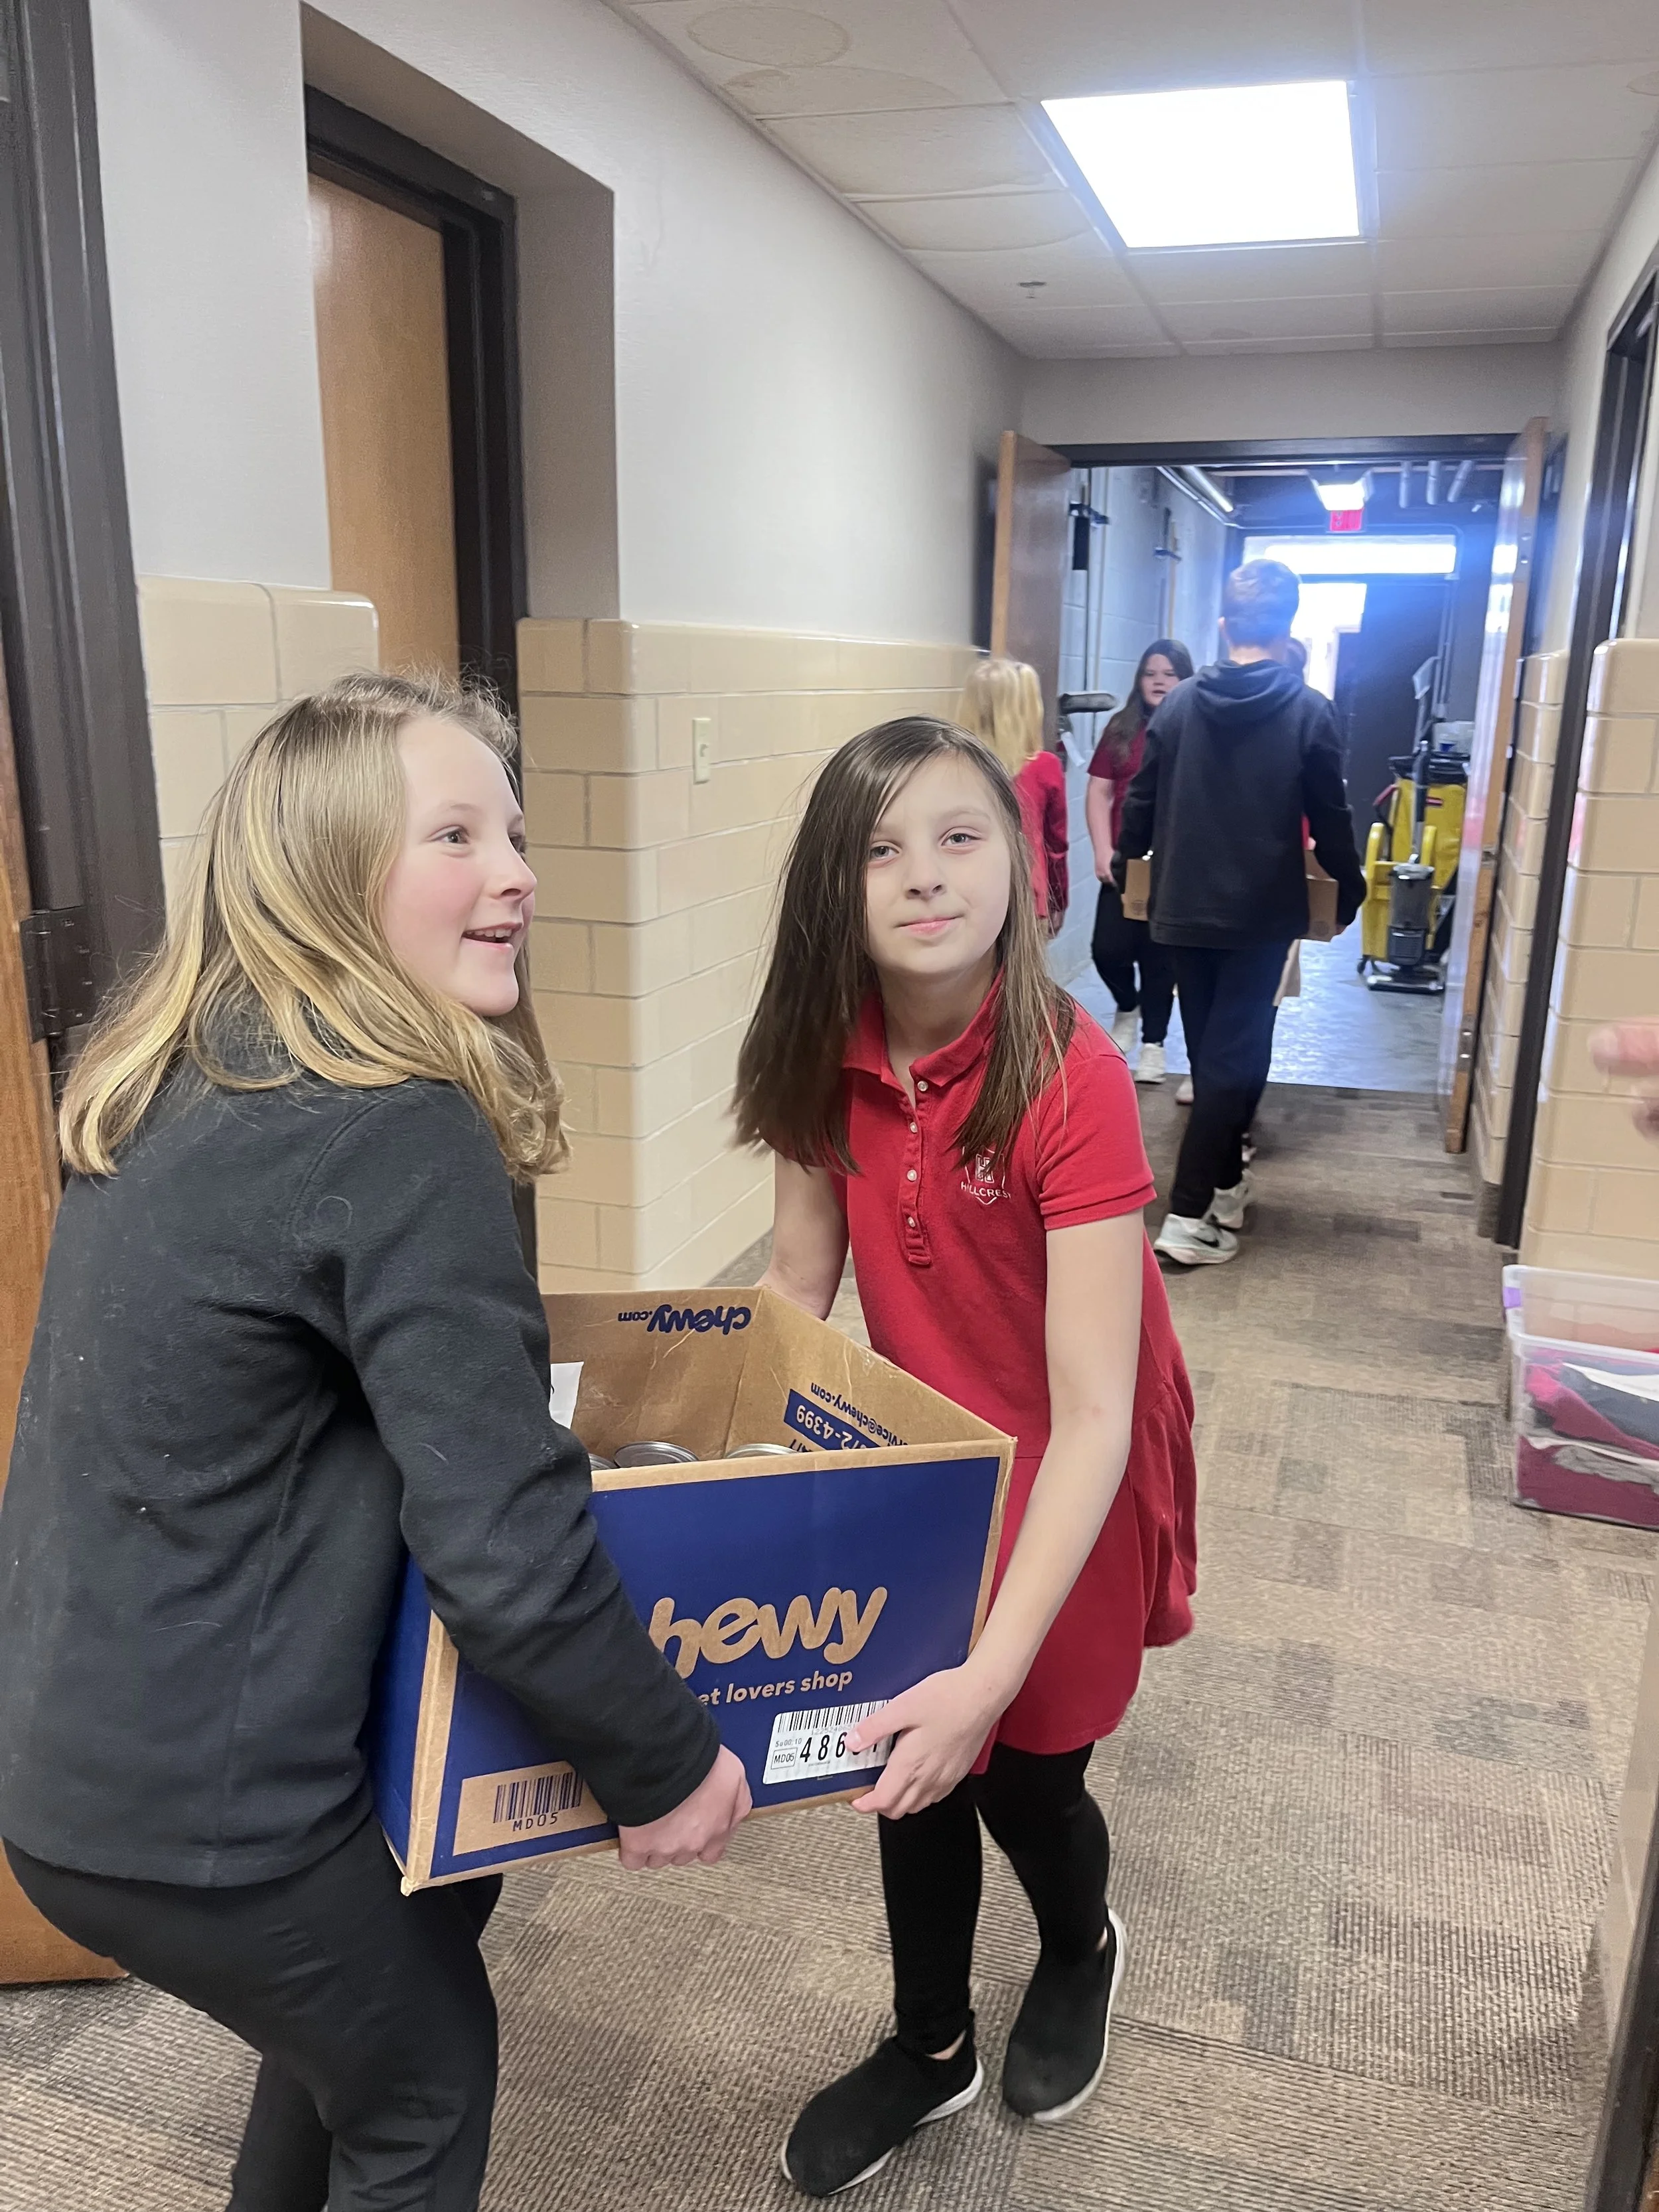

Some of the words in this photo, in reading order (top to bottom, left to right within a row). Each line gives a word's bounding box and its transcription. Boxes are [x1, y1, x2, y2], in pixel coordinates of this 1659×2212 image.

[648, 1586, 888, 1678] hewy
[699, 1688, 721, 1706] et
[725, 1680, 796, 1704] lovers
[800, 1670, 853, 1693] shop
